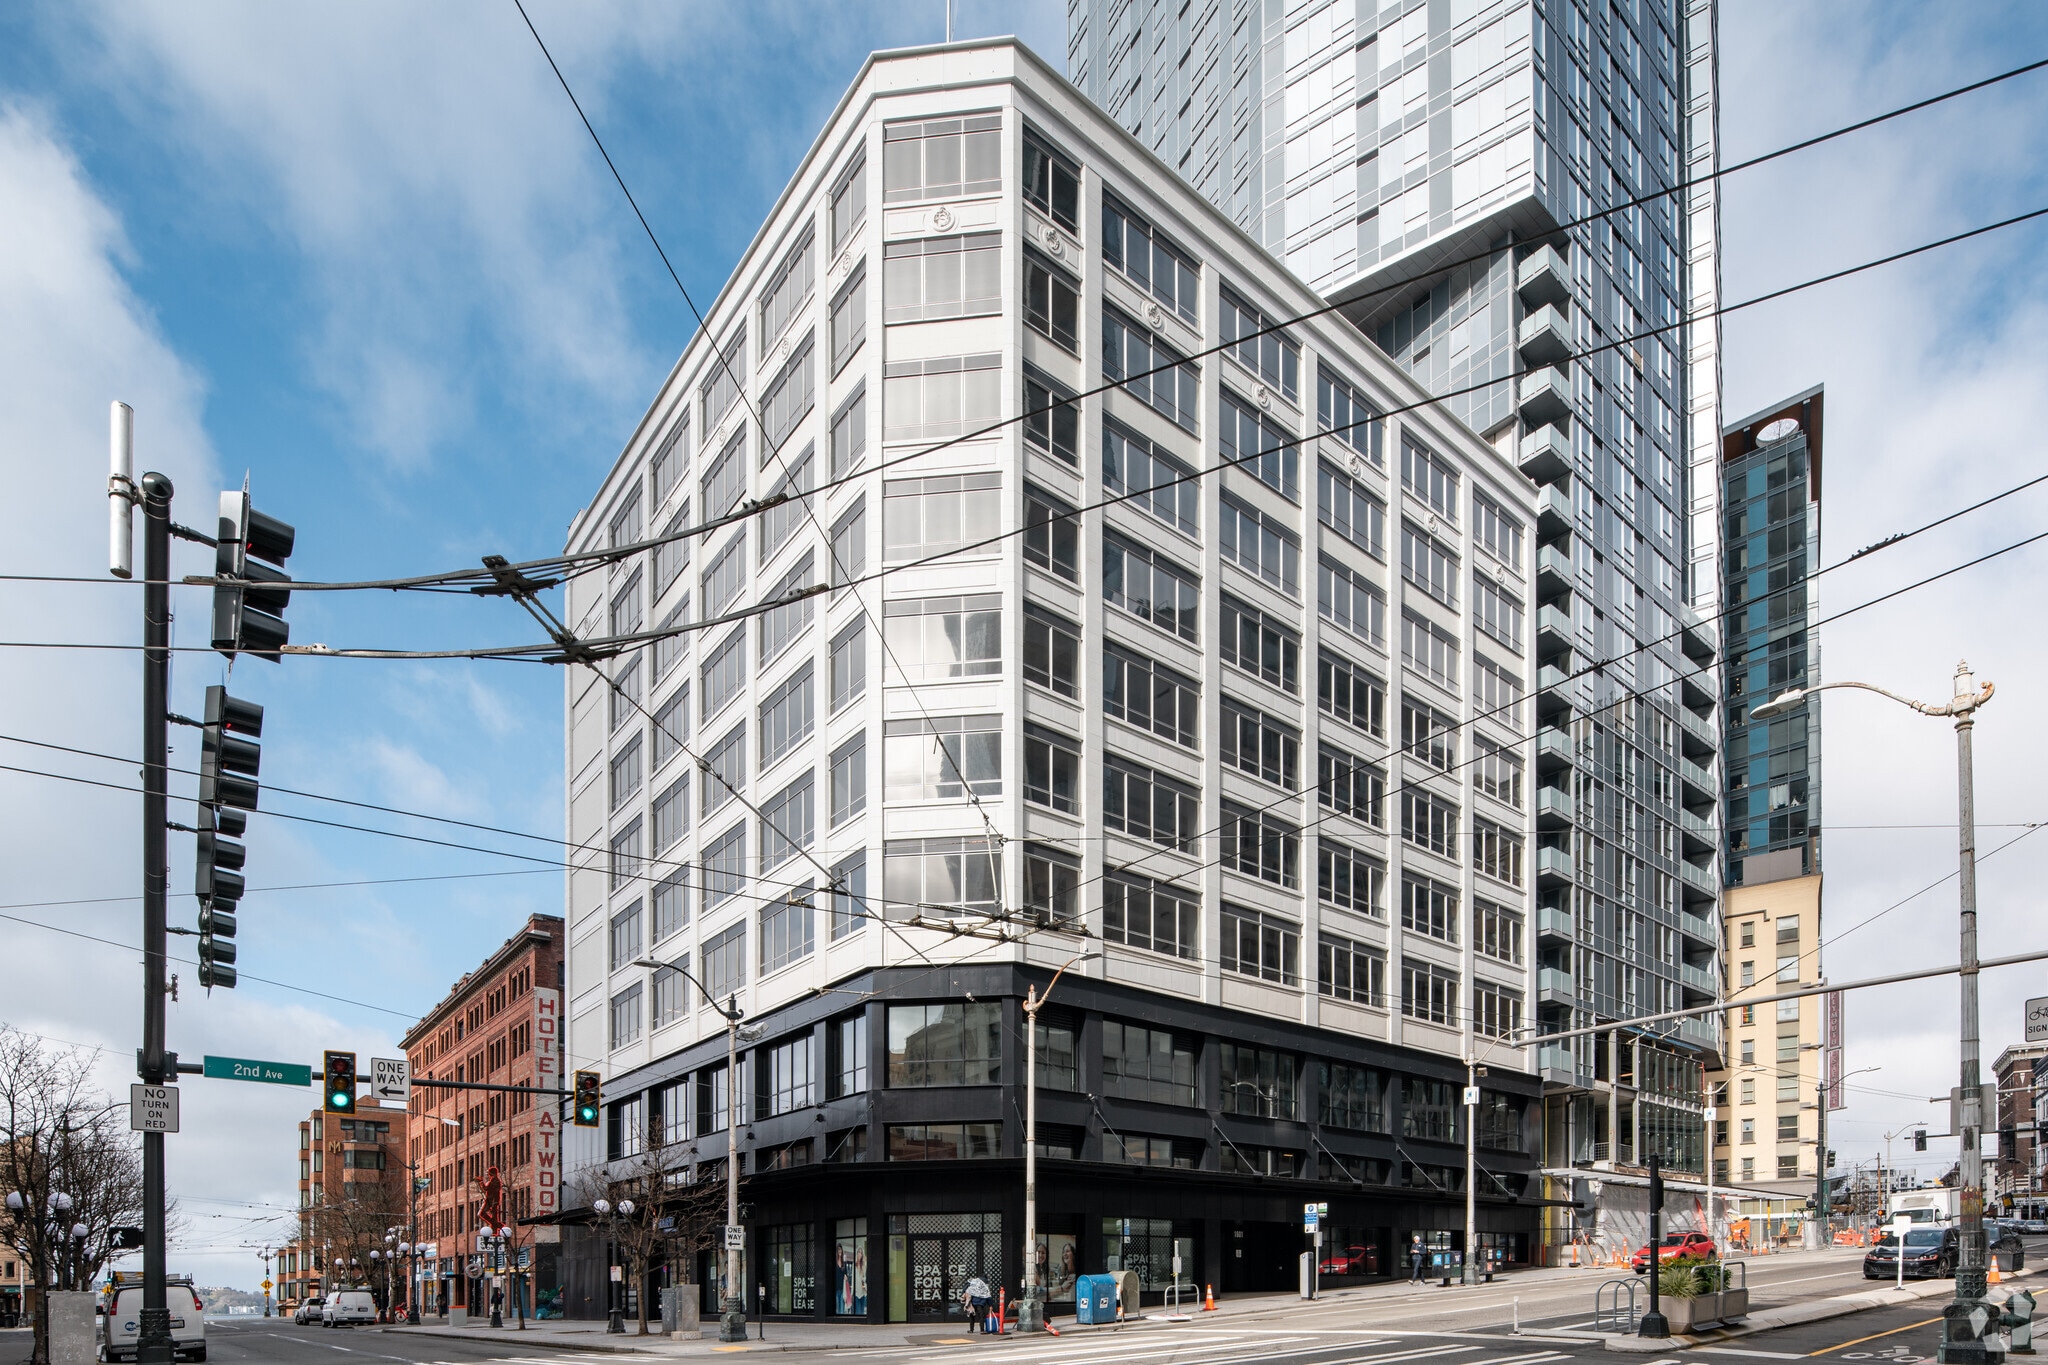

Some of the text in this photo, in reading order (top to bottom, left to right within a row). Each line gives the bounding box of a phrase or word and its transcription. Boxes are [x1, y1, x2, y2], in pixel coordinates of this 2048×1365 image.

[2028, 1024, 2048, 1034] SIGN
[234, 1063, 283, 1080] 2nd Ave
[377, 1061, 405, 1074] ONE
[376, 1073, 405, 1085] WAY
[144, 1088, 166, 1099] NO
[141, 1099, 169, 1109] TURN
[148, 1110, 163, 1119] ON
[145, 1119, 166, 1129] RED
[914, 1264, 967, 1276] SPACE
[914, 1277, 942, 1288] FOR
[793, 1288, 807, 1298] FOR
[914, 1289, 965, 1300] LEASE
